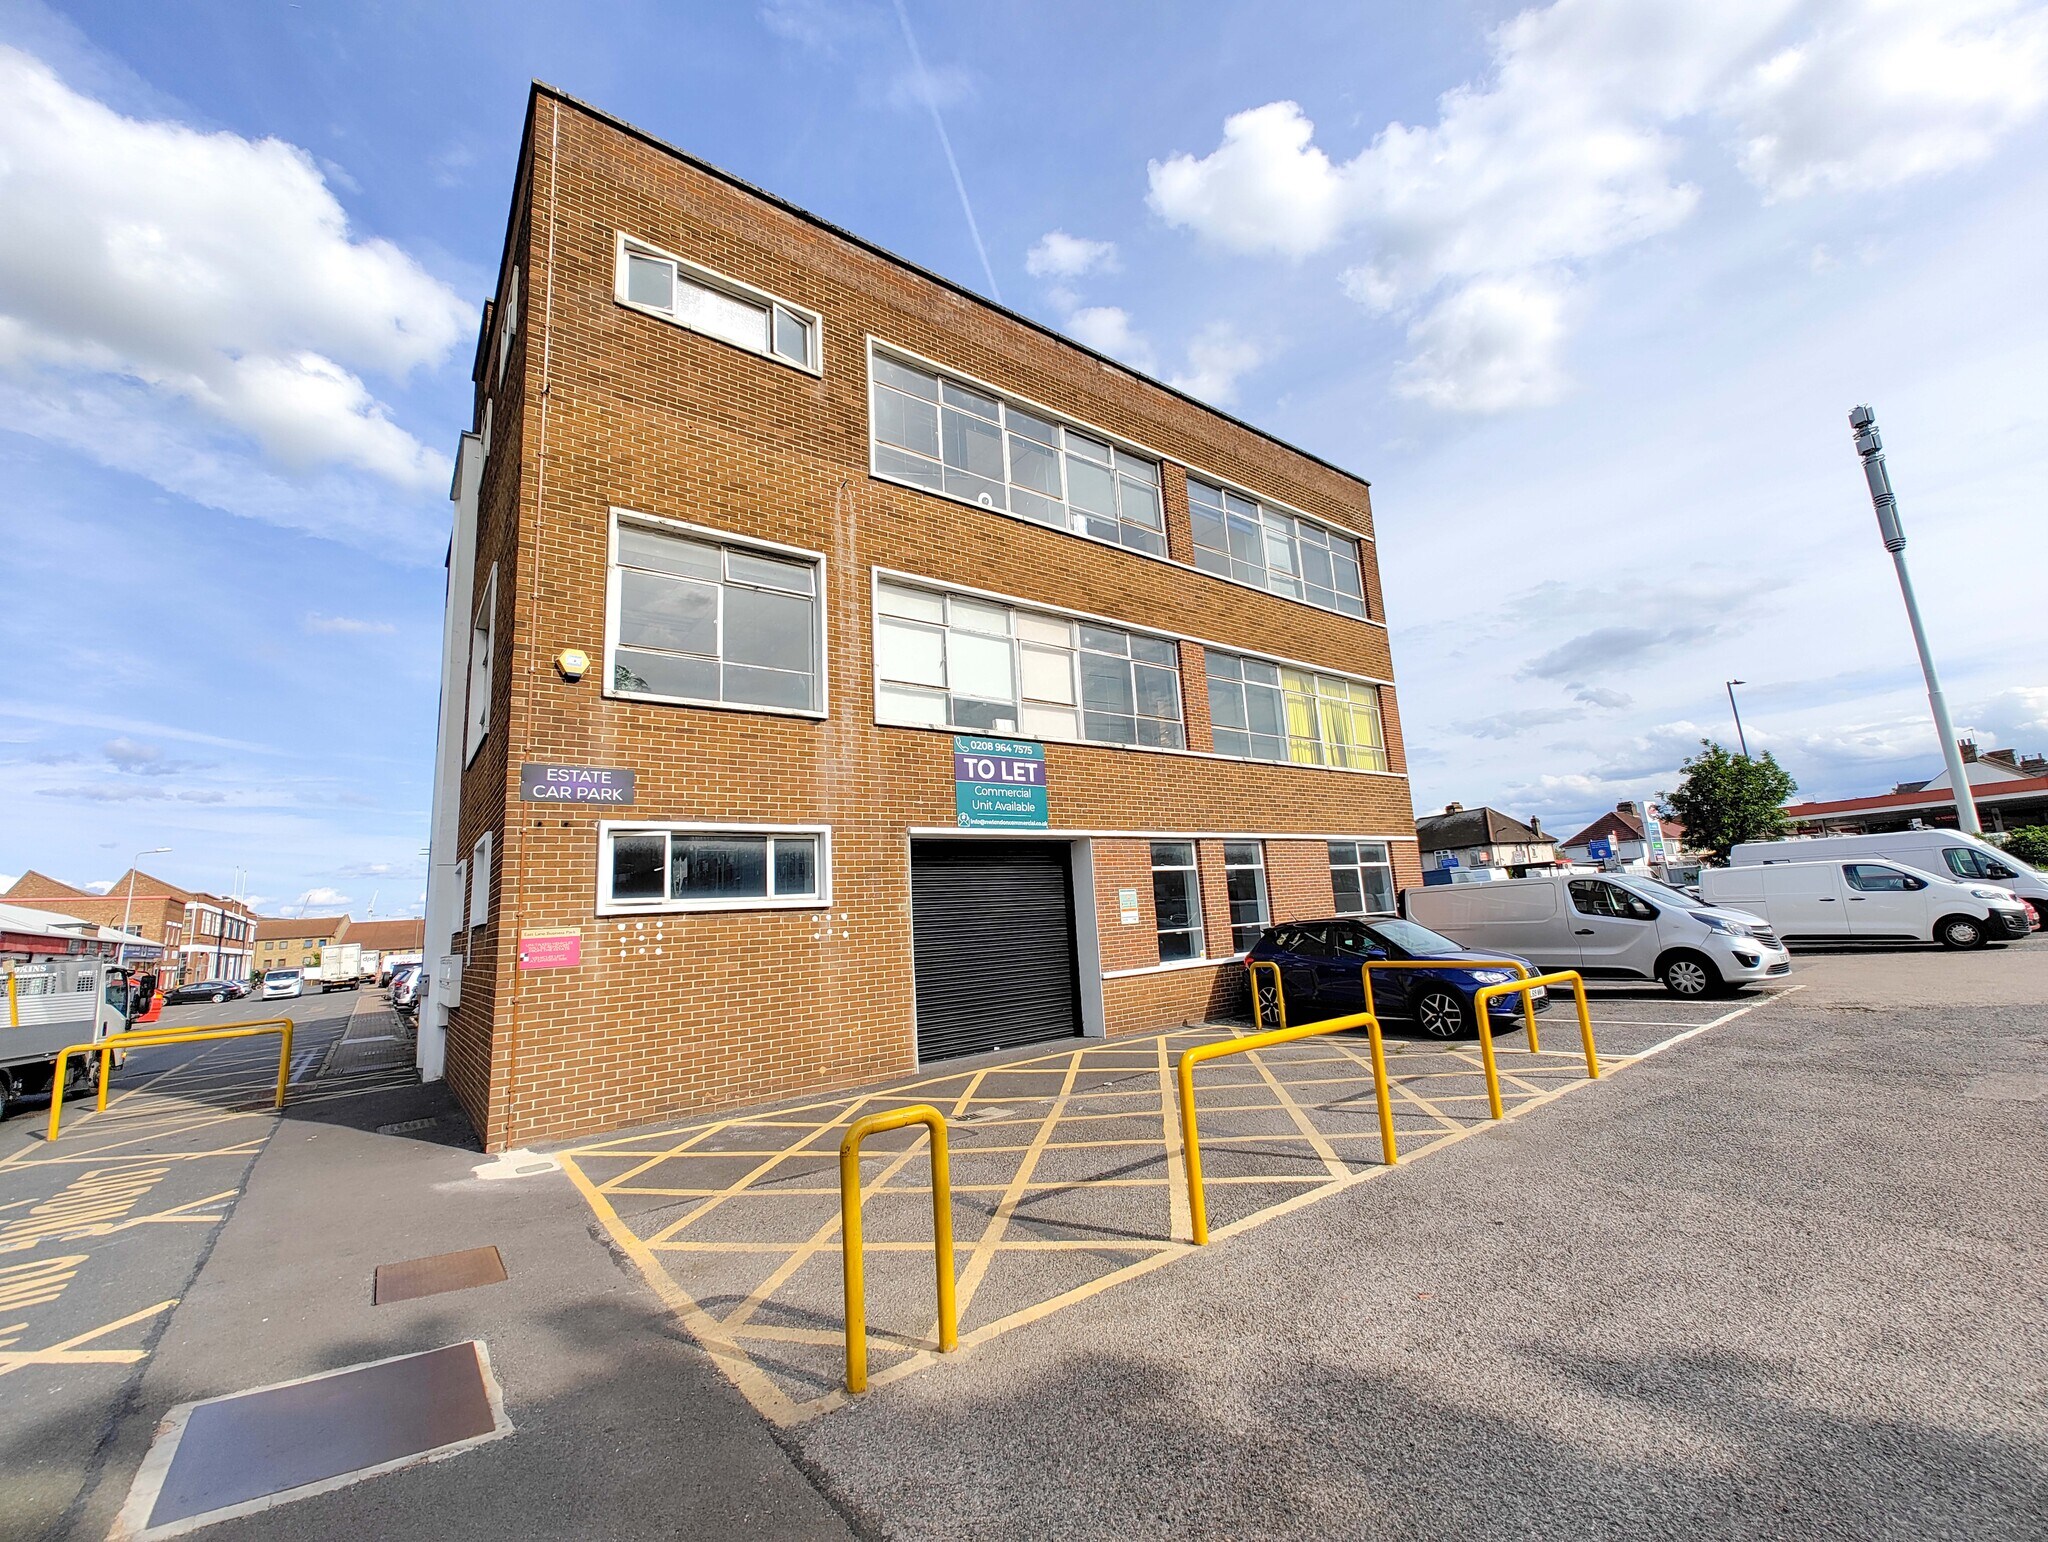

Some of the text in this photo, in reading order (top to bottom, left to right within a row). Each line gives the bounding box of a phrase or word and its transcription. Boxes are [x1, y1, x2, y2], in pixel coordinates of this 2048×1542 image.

[970, 740, 1033, 755] 0208 964 7575
[546, 768, 612, 784] ESTATE
[963, 757, 1038, 783] TO LET
[532, 785, 623, 801] CAR PARK
[974, 785, 1032, 798] Commercial
[972, 799, 1036, 812] Unit Available
